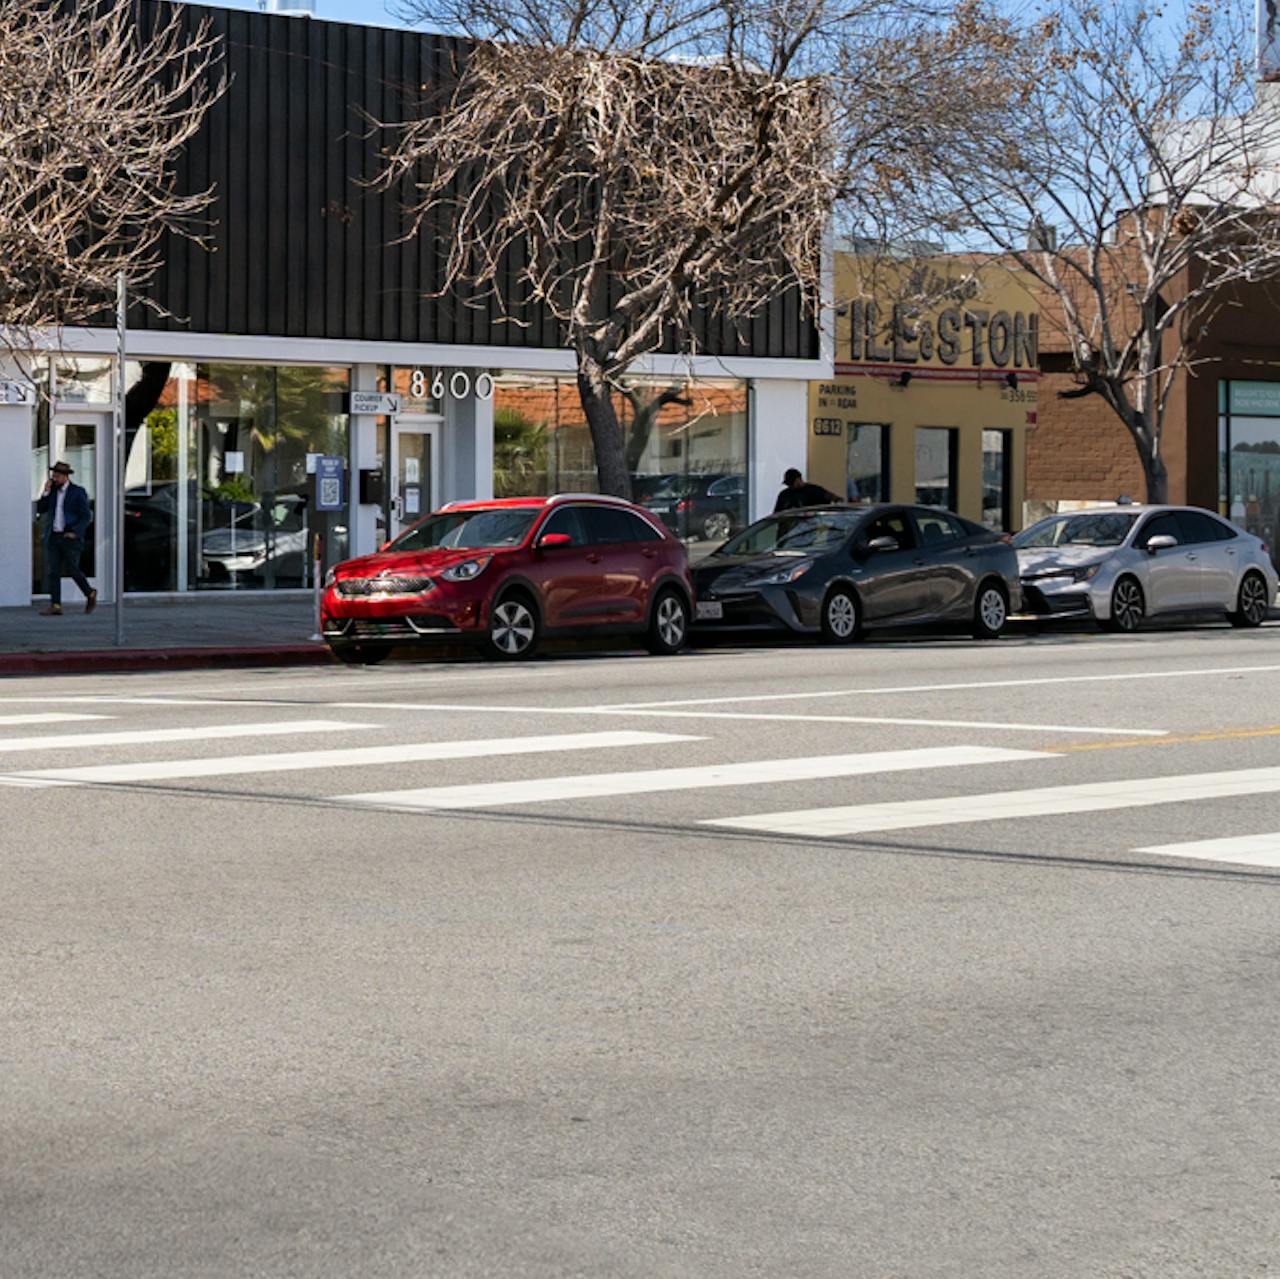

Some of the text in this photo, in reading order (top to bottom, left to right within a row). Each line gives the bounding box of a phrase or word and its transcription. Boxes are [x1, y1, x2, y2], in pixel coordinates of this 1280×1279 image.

[411, 371, 495, 400] 8600
[354, 393, 383, 402] COURIER
[354, 403, 379, 412] PICKUP
